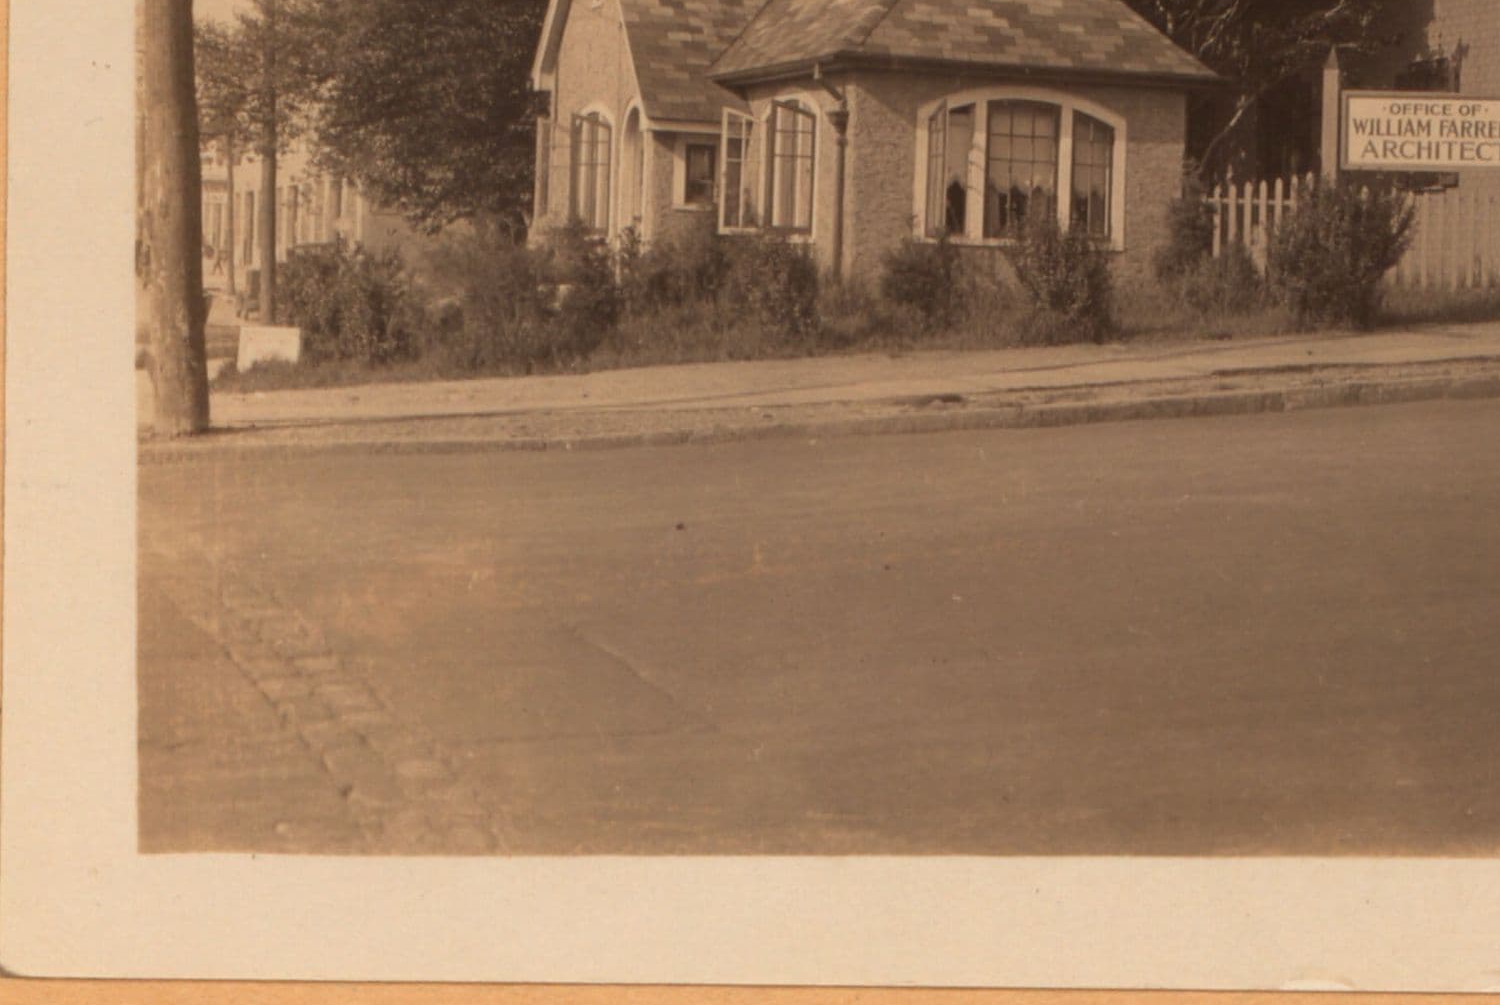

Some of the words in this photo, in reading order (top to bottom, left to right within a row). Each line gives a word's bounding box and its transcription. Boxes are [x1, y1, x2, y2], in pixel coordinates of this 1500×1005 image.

[1389, 103, 1452, 116] OFFICE
[1459, 103, 1482, 116] OF
[1353, 118, 1431, 137] WILLIAM
